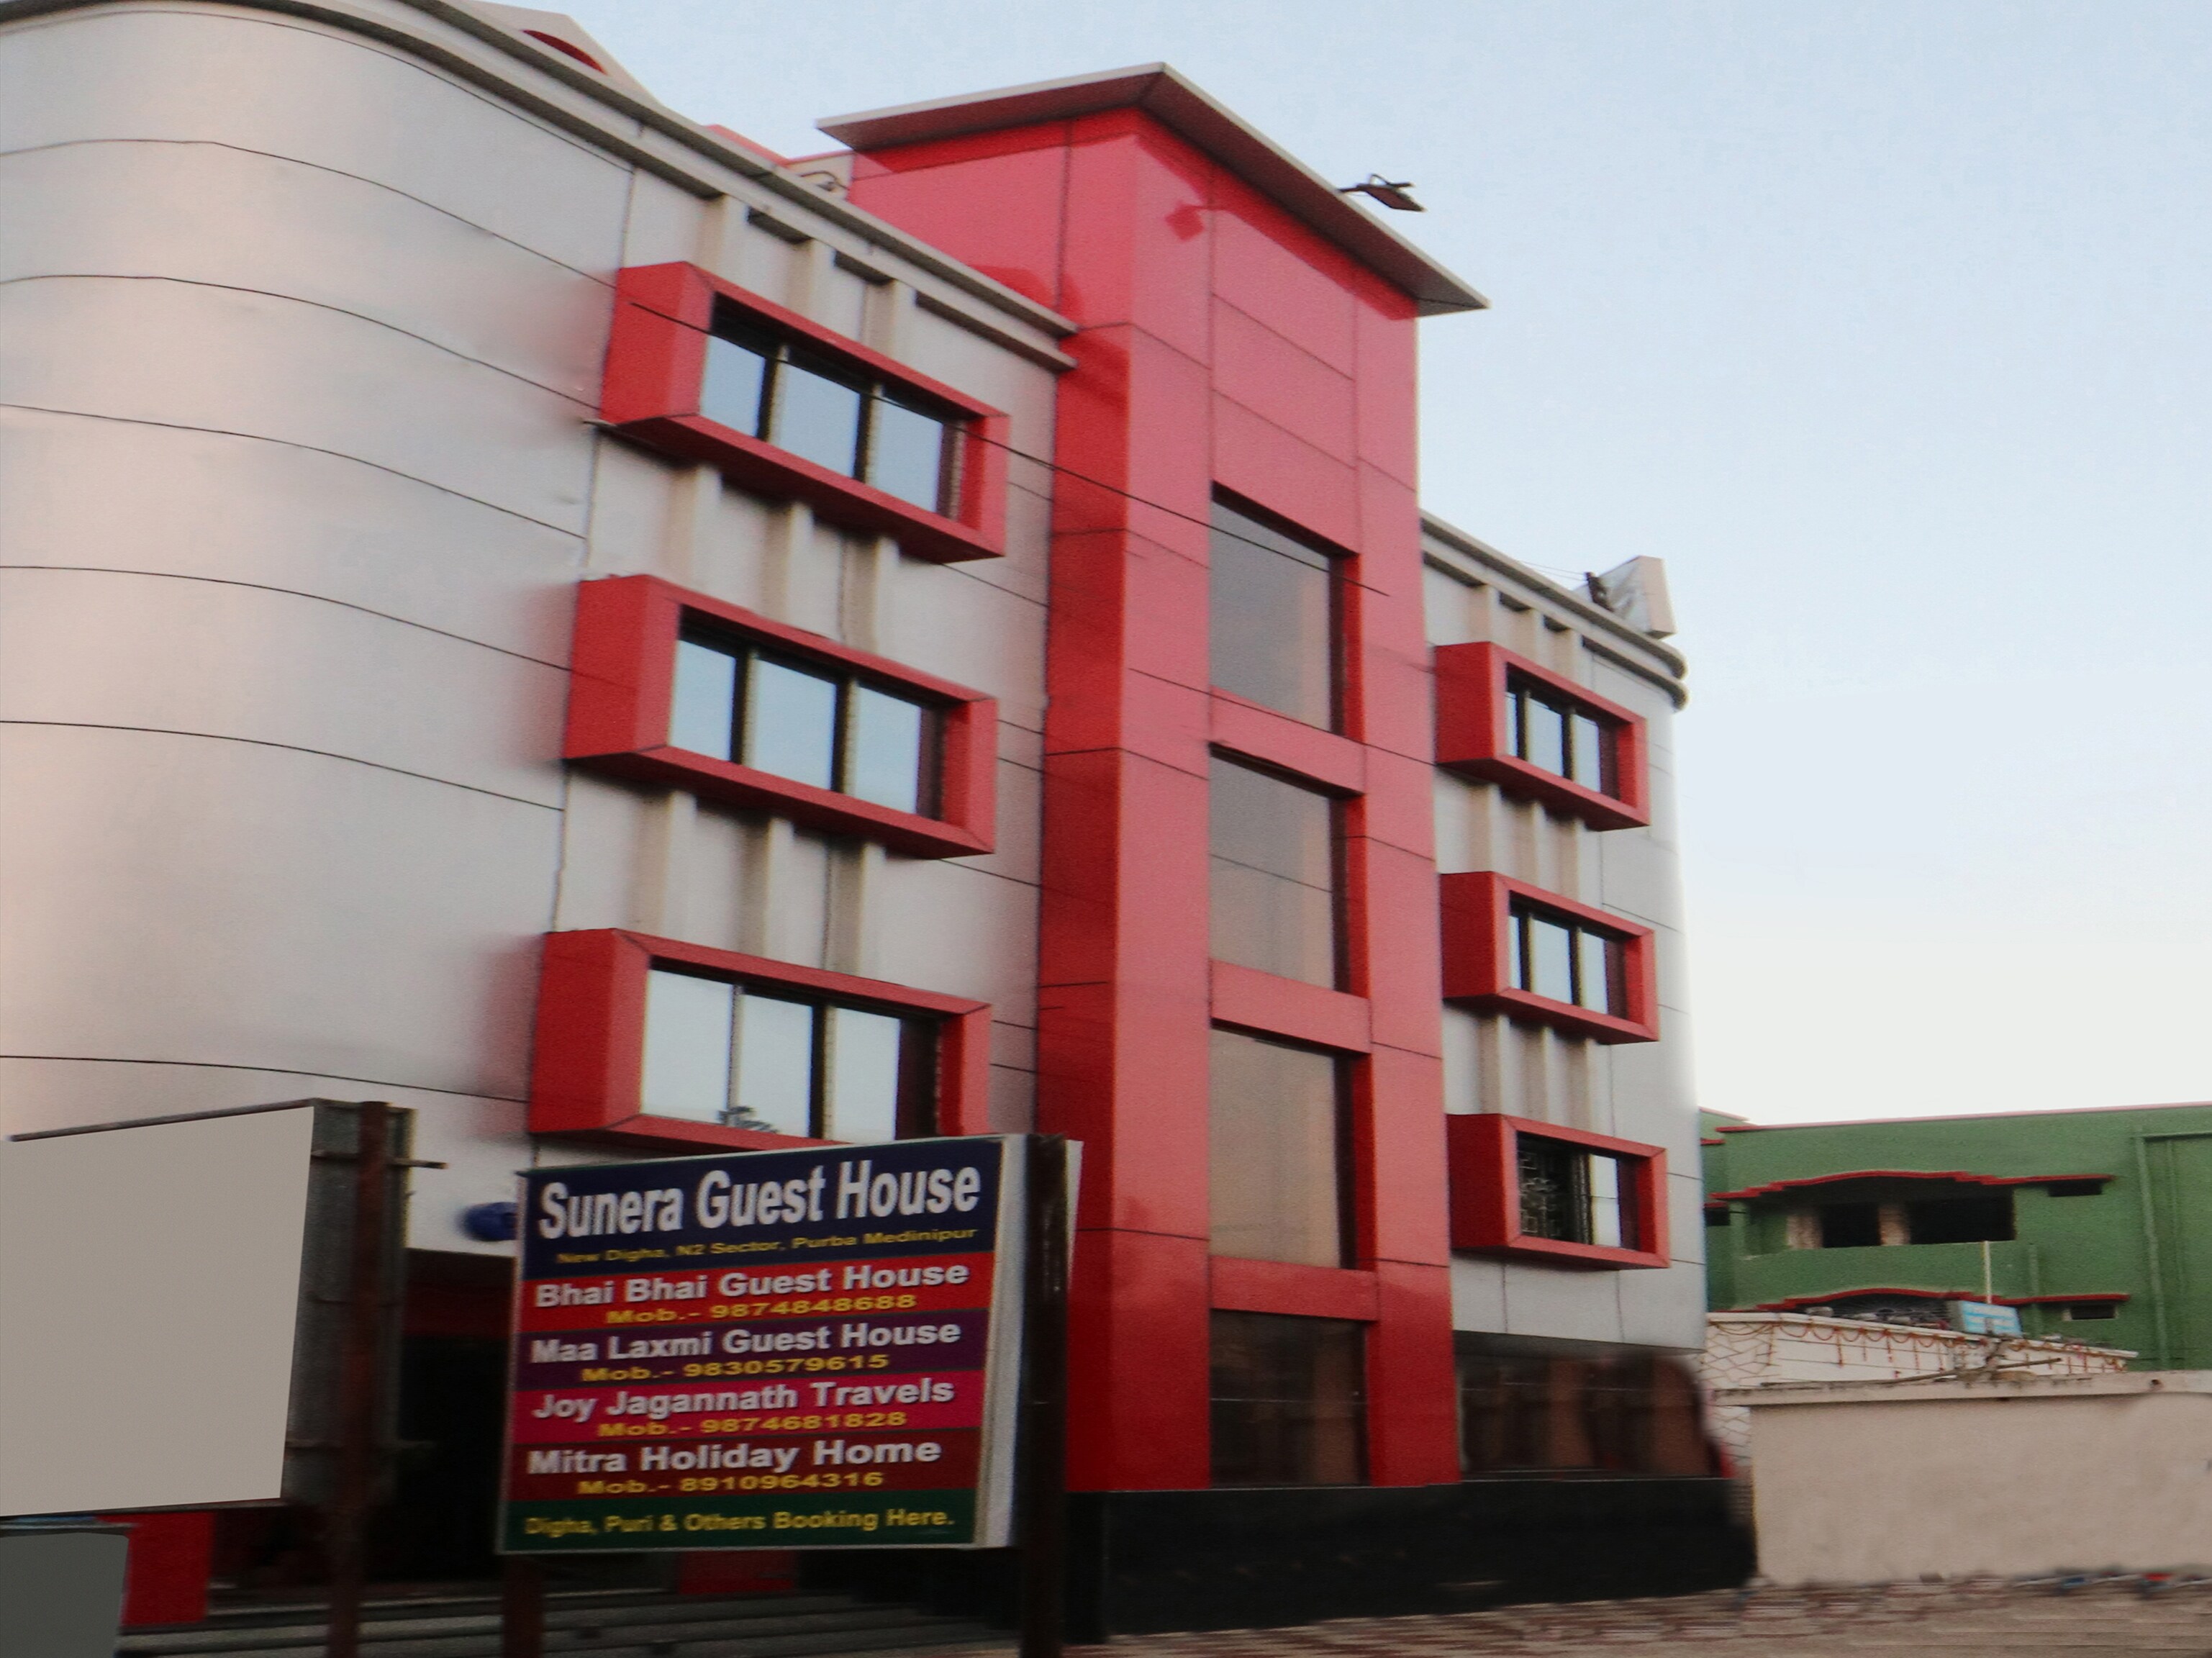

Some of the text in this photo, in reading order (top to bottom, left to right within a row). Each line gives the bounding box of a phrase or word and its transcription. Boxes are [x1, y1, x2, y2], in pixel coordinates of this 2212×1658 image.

[540, 1159, 981, 1239] Sunera Guest House
[792, 1236, 857, 1249] Purba
[864, 1228, 979, 1245] Medinipur
[535, 1264, 969, 1308] Bhai Bhai Guest House
[606, 1295, 917, 1323] Mob.- 9874848688
[531, 1323, 961, 1364] Maa Laxmi Guest House
[581, 1354, 889, 1382] Mob.- 9830579615
[532, 1377, 956, 1423] Joy Jagannath Travels
[597, 1411, 908, 1437] Mob.- 9874681828
[527, 1439, 942, 1474] Mitra Holiday Home
[578, 1472, 884, 1495] Mob.- 8910964316
[603, 1515, 654, 1533] Puri
[658, 1514, 678, 1531] &
[684, 1513, 766, 1531] Others
[773, 1510, 879, 1531] Booking
[885, 1508, 955, 1527] Here.
